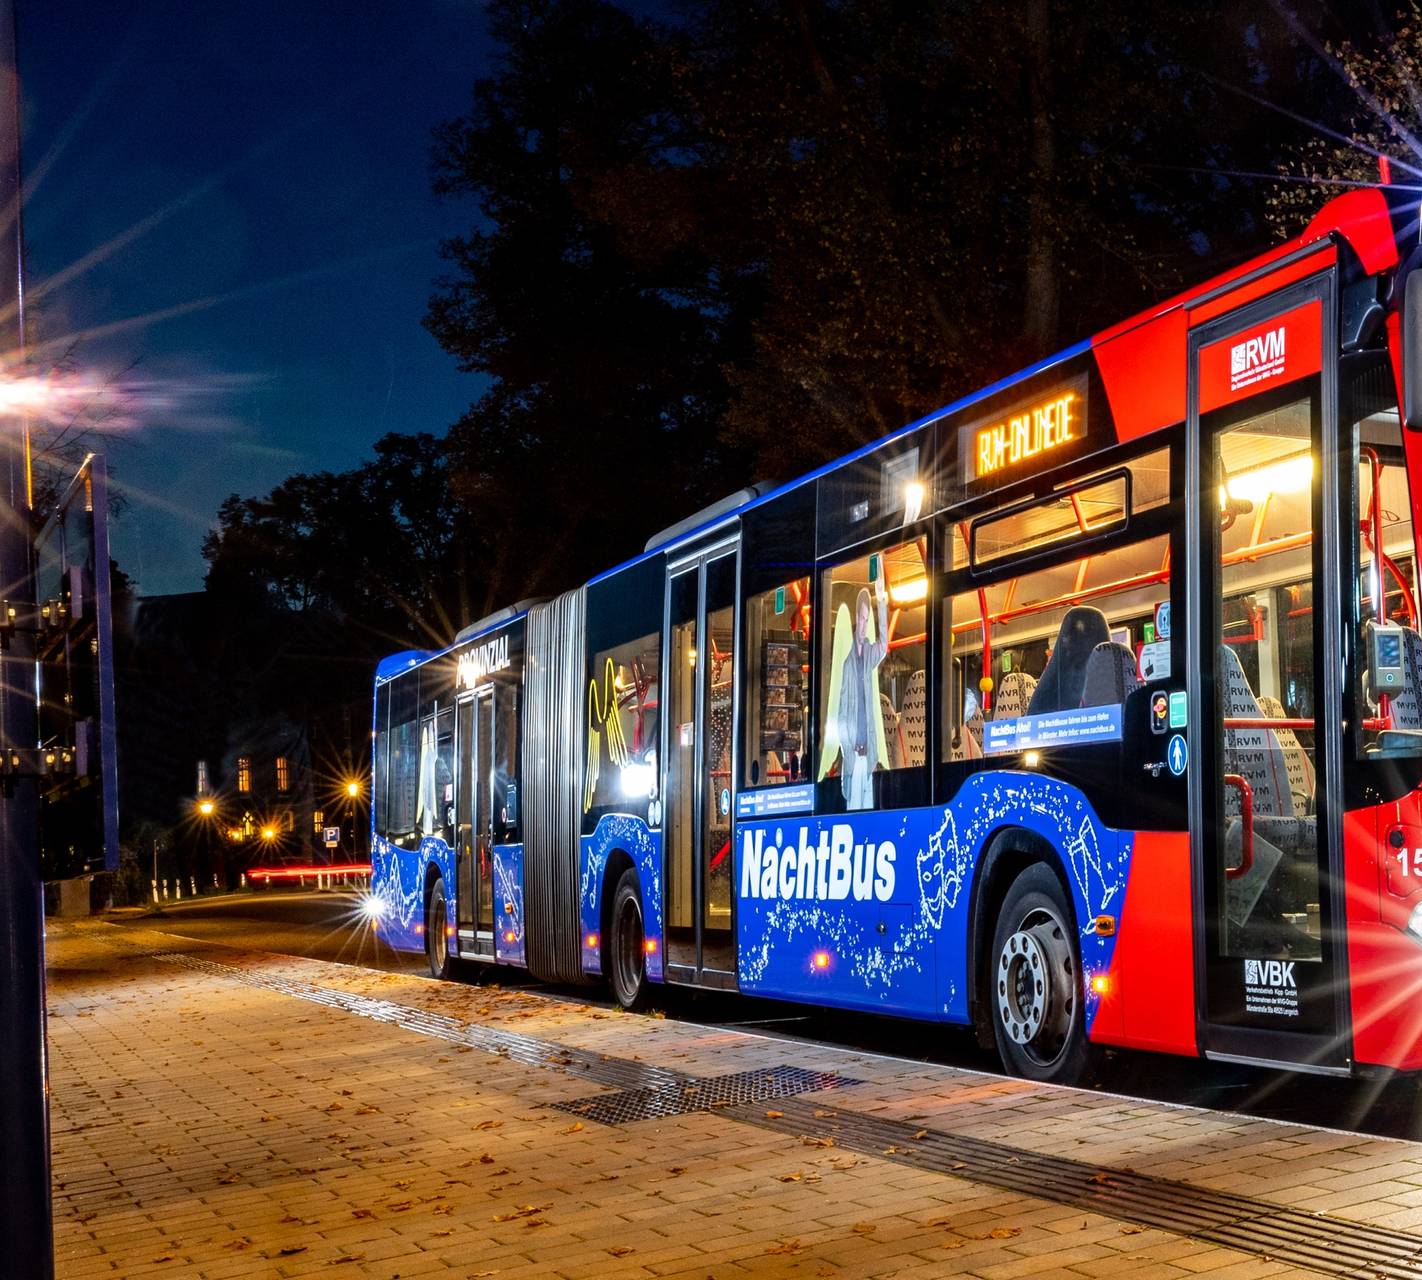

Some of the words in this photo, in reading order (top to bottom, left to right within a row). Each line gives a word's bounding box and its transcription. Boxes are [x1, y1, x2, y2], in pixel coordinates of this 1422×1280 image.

[1246, 327, 1285, 369] RVM
[1232, 703, 1256, 713] RVM
[1236, 737, 1262, 747] RVM
[1238, 753, 1265, 763] RVM
[327, 829, 336, 841] P
[741, 824, 897, 902] NachtBus
[1257, 960, 1296, 987] VBK
